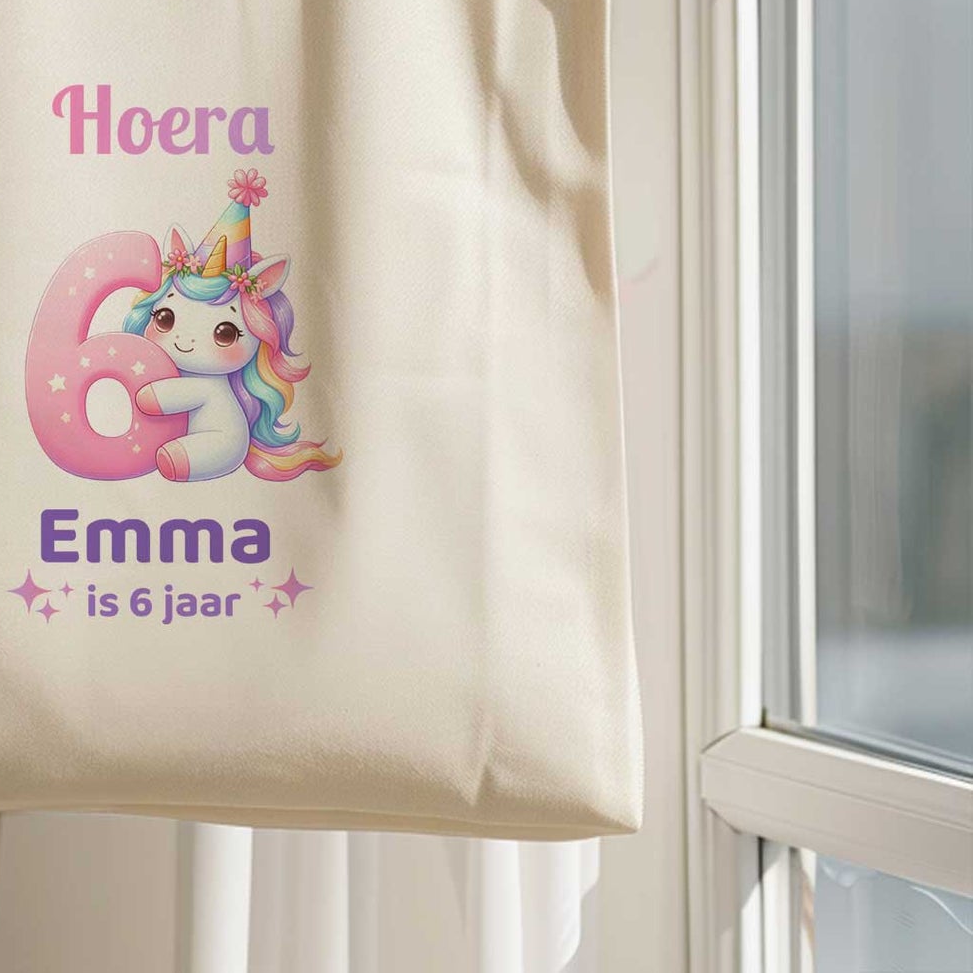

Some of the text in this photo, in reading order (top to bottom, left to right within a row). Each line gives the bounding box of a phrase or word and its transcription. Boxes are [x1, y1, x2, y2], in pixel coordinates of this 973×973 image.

[51, 83, 275, 156] Hoera
[25, 232, 188, 481] 6
[41, 508, 271, 563] Emma
[87, 583, 241, 624] is 6 jaar
